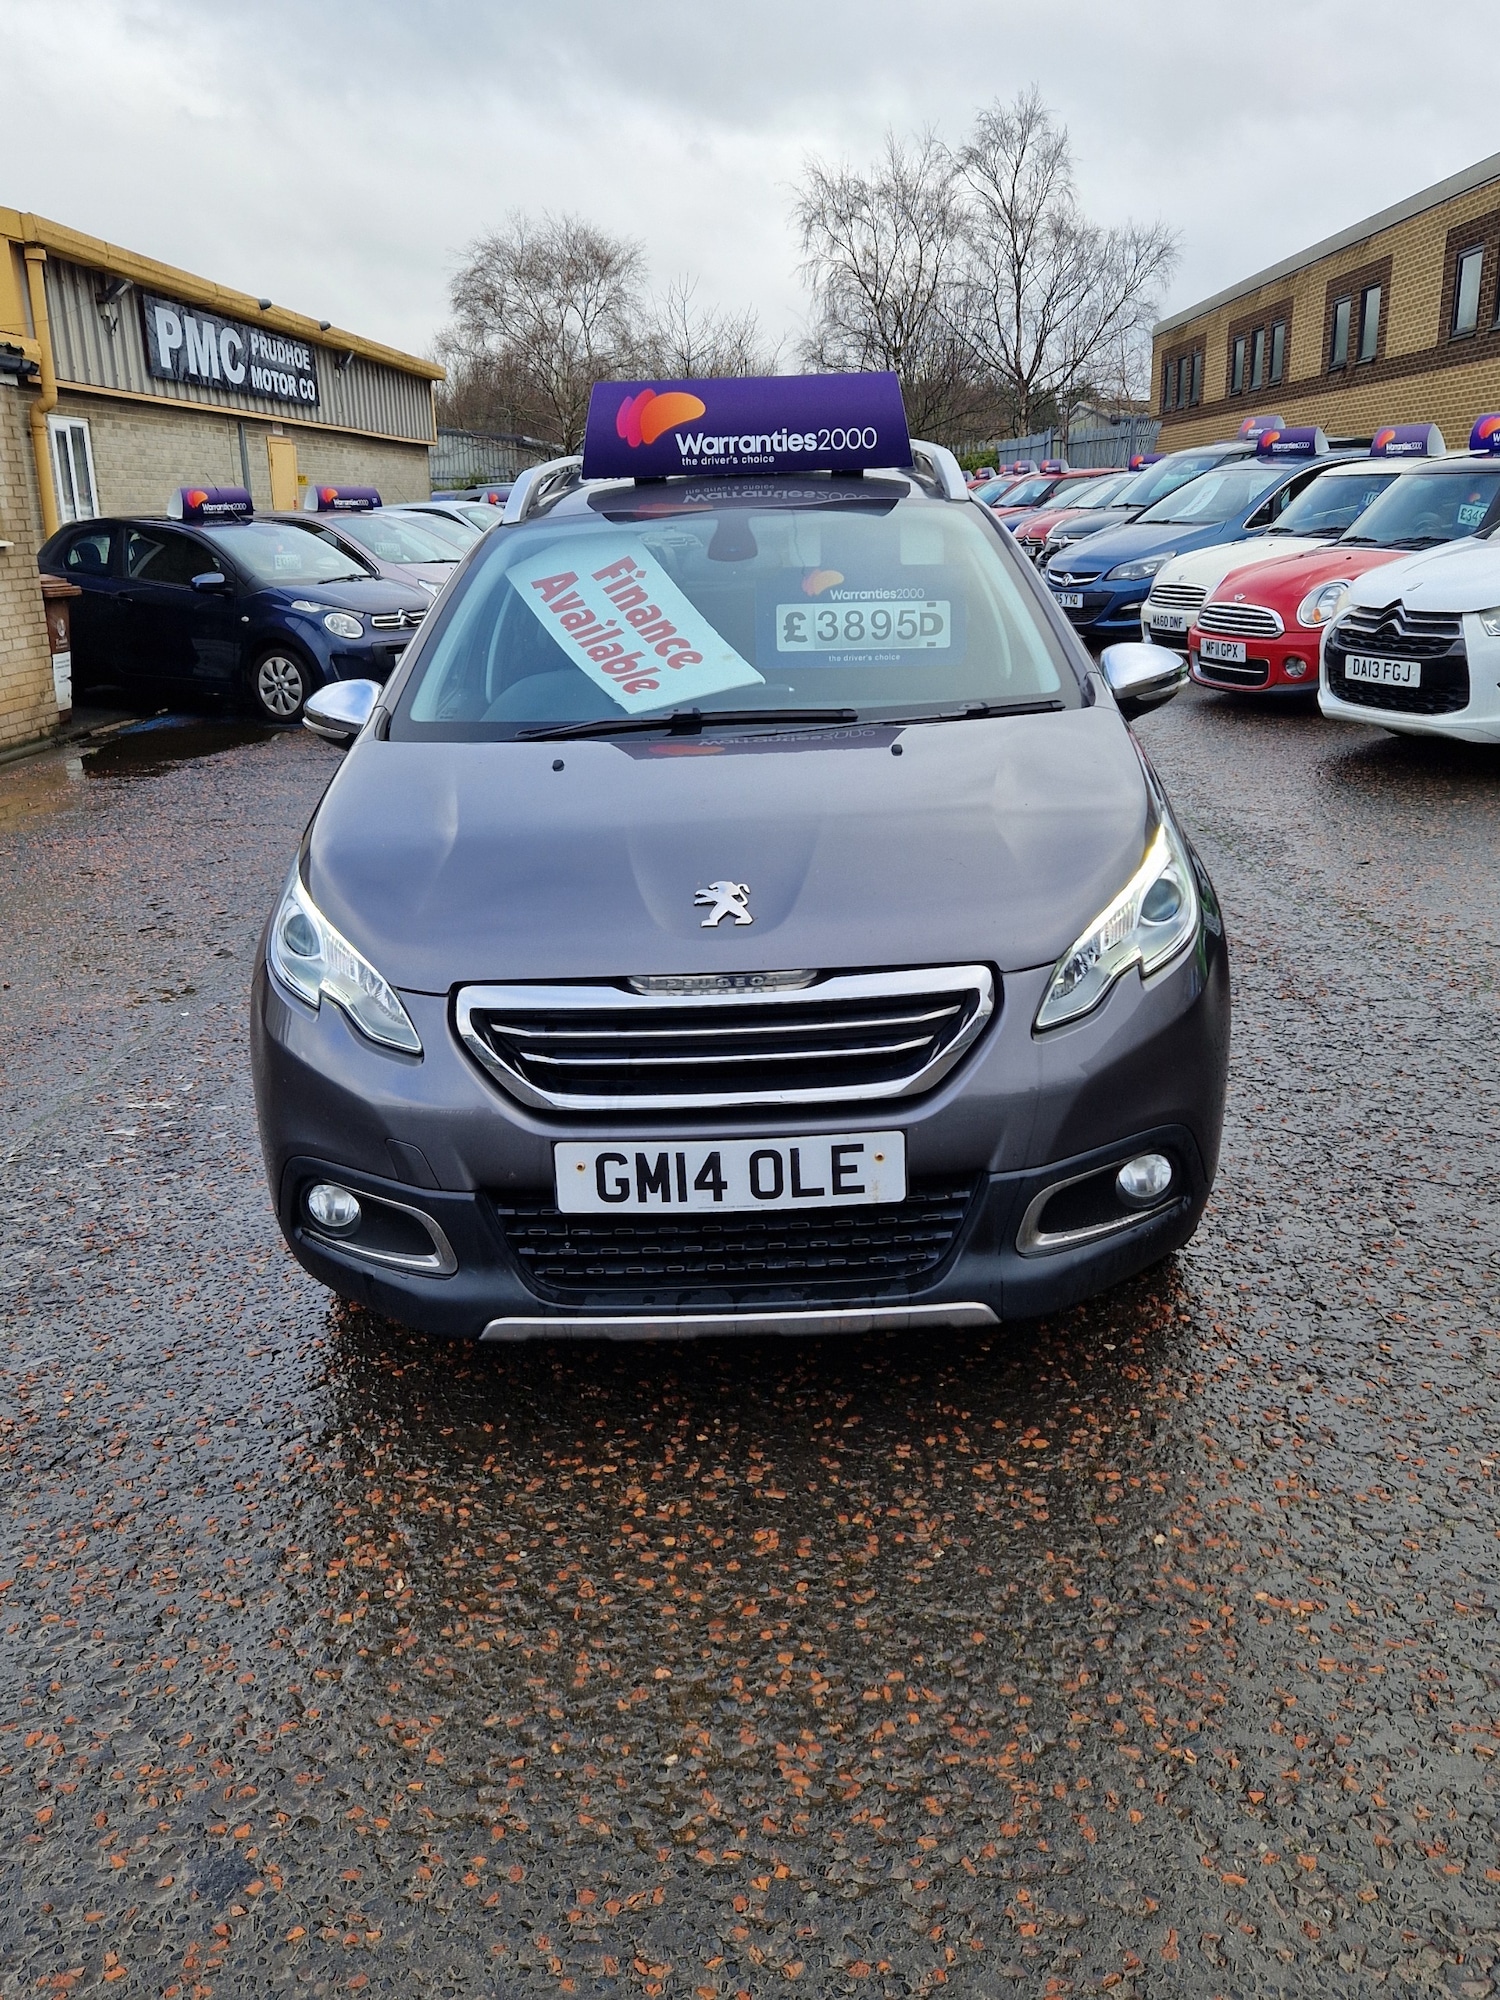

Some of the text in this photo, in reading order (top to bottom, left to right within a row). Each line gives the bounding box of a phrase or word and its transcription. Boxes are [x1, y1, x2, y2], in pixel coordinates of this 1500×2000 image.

[154, 306, 246, 385] PMC
[250, 332, 312, 371] PRUDHOE
[250, 365, 316, 401] MOTOR CO
[675, 426, 877, 456] Warranties2000
[681, 454, 775, 467] the driver's choice
[830, 588, 924, 600] Warranties2000
[591, 555, 704, 670] Finance
[530, 571, 661, 695] Available
[874, 653, 901, 661] choice
[1221, 643, 1238, 658] GPX
[1353, 658, 1411, 682] DA13 FGJ
[595, 1143, 866, 1204] GM14 OLE
